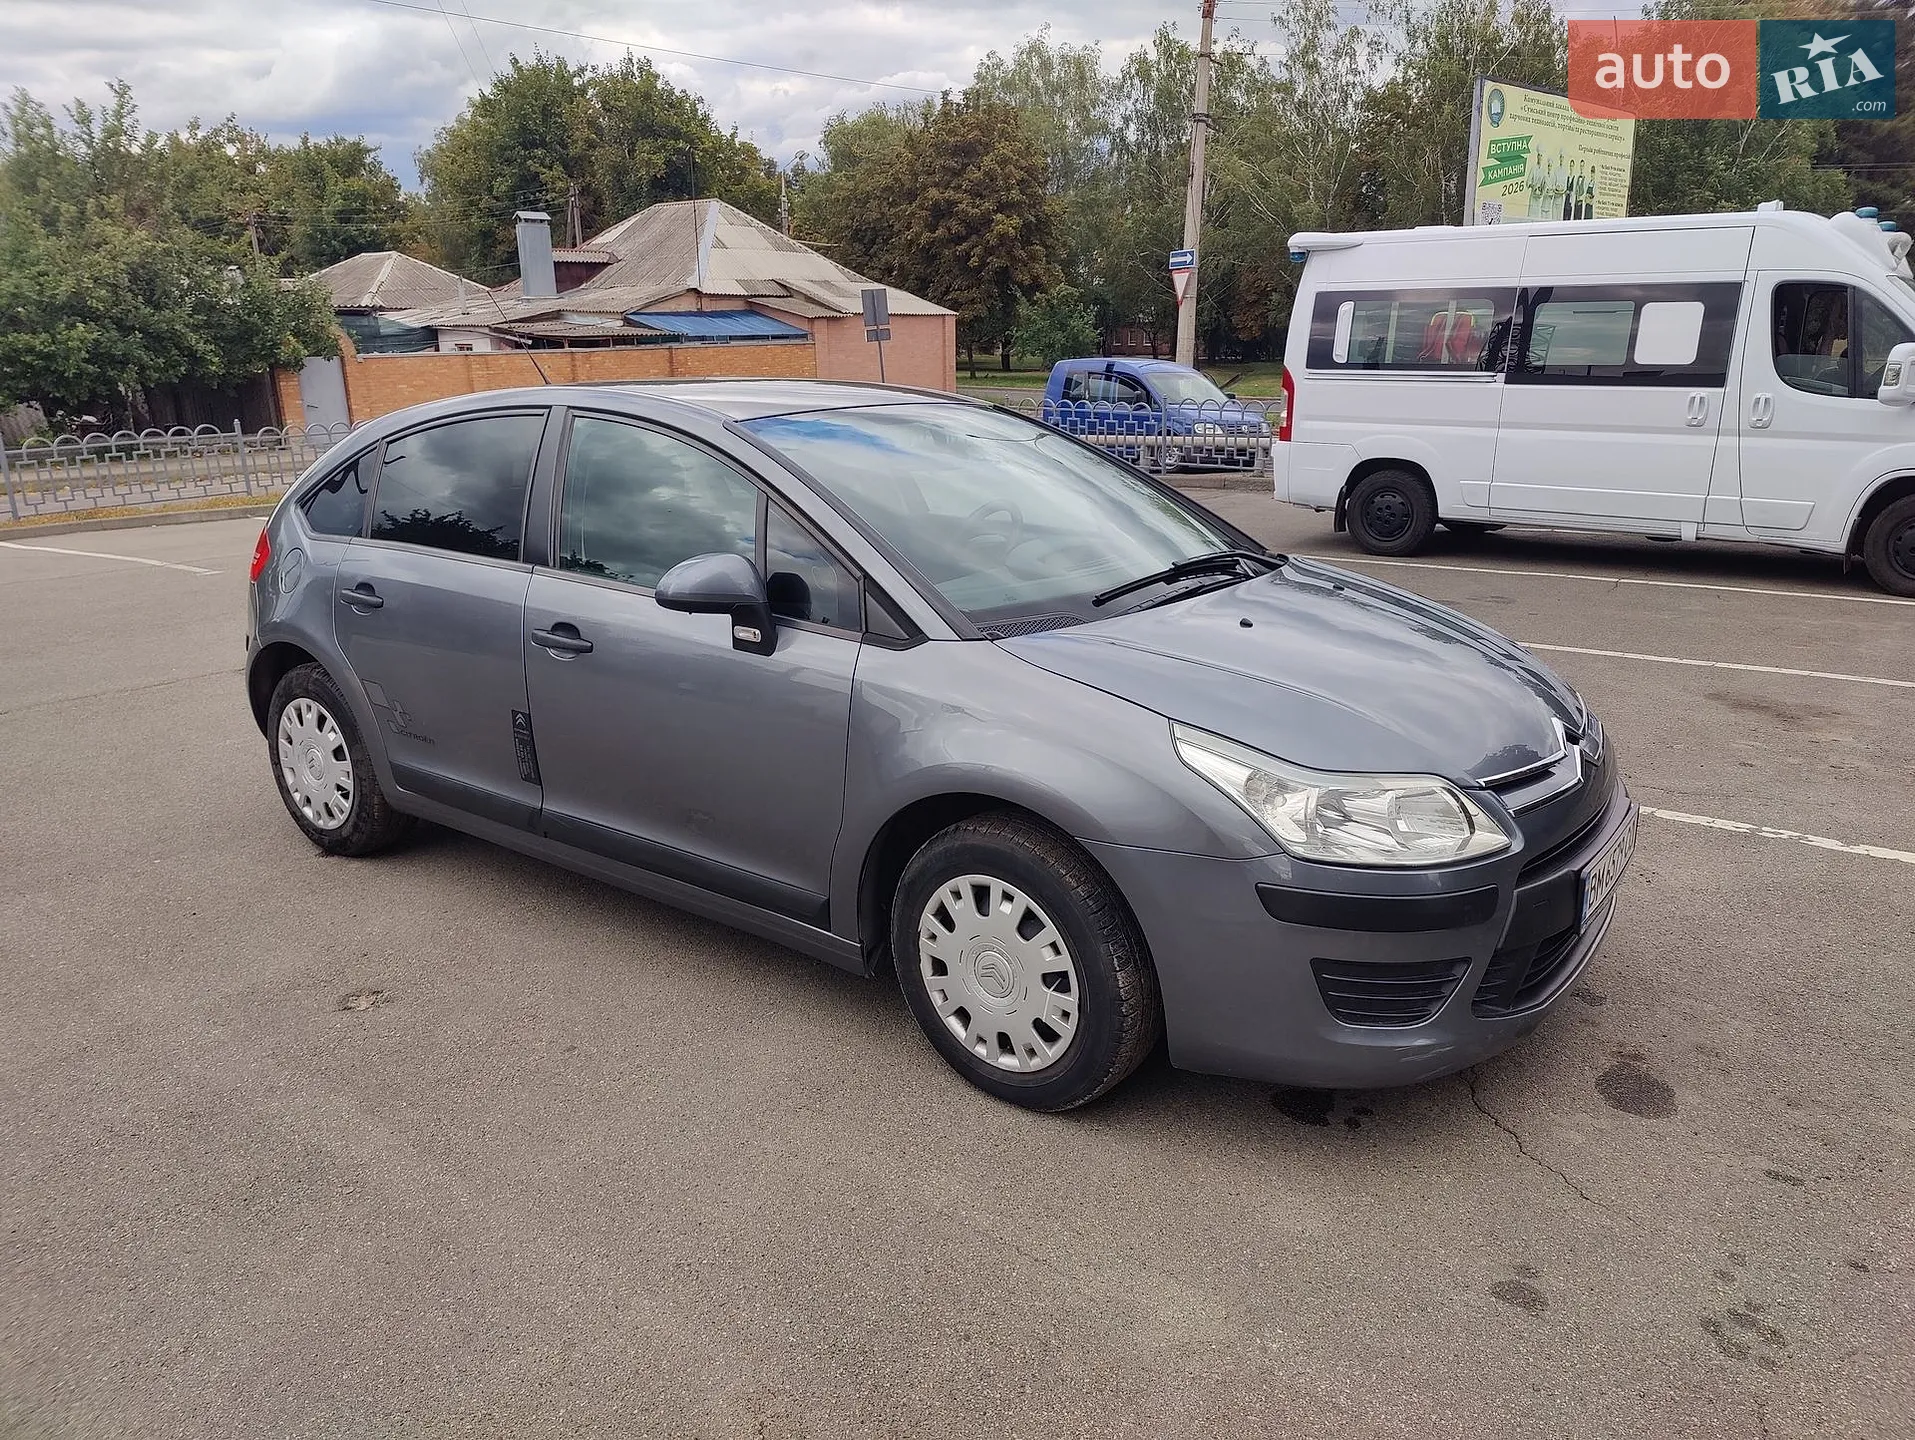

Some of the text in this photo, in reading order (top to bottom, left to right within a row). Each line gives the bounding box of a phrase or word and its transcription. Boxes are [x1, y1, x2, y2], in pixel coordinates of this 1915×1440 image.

[1490, 139, 1528, 154] ВСТУПНА
[1488, 163, 1525, 180] КАМПАНІЯ
[1501, 180, 1525, 197] 2026
